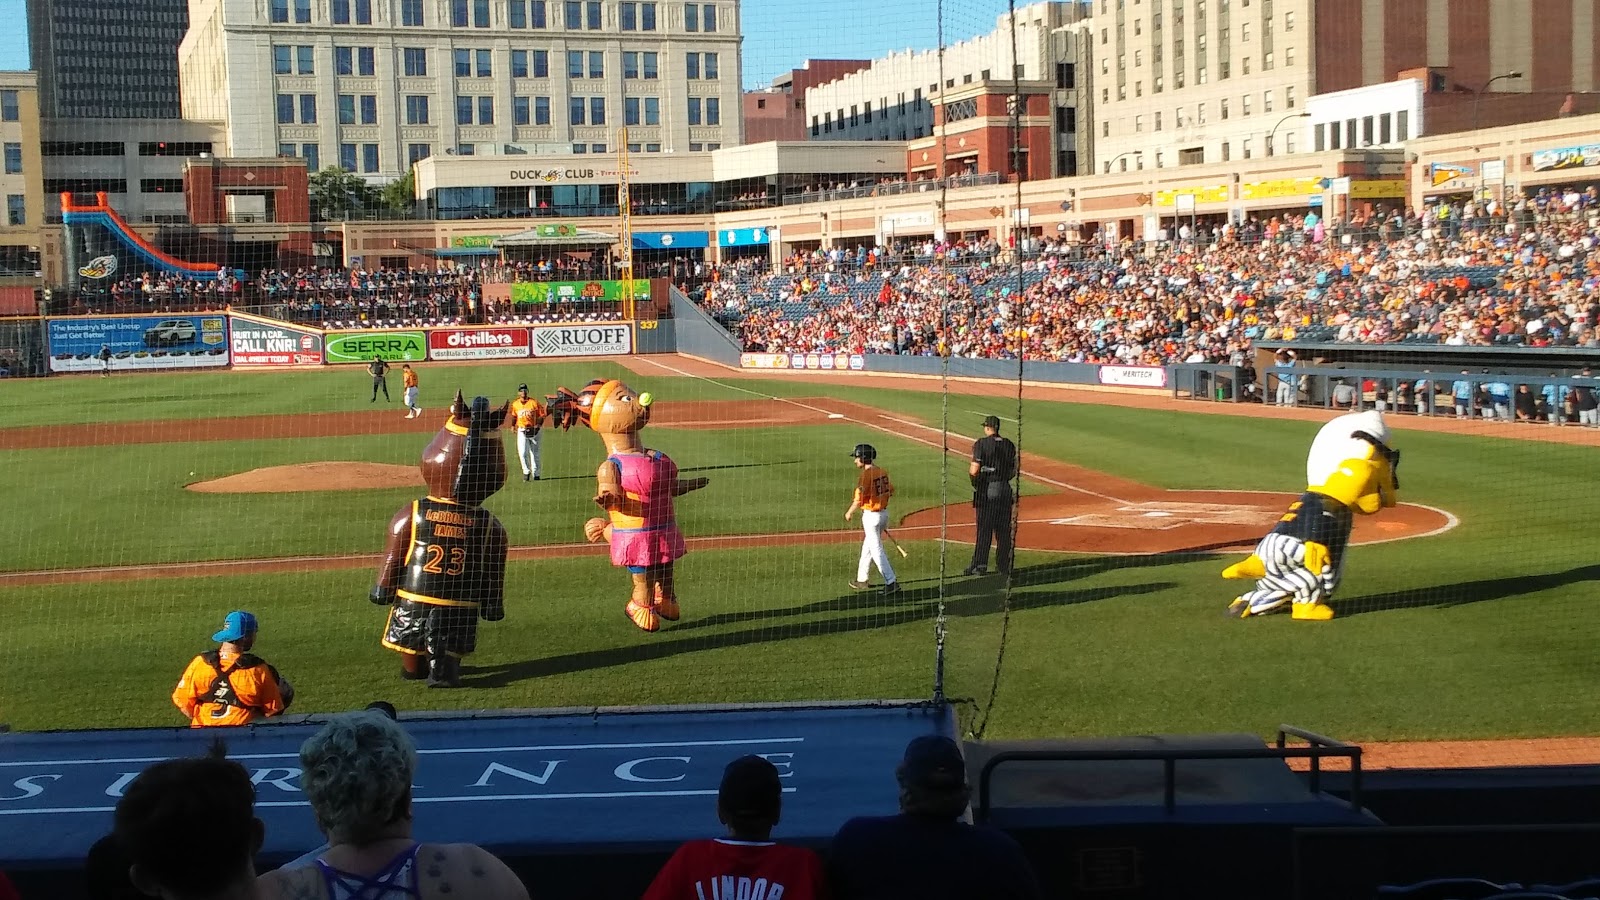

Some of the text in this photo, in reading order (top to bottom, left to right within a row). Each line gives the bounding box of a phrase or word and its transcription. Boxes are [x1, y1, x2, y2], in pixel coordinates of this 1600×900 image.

[510, 169, 594, 180] DUCK CLUB
[67, 324, 100, 332] Industry's
[117, 322, 140, 331] Lineup
[640, 321, 658, 330] 337
[233, 331, 251, 339] HURT
[447, 331, 513, 347] distillata
[561, 329, 625, 344] RUOFF
[234, 339, 264, 352] CALL
[266, 339, 297, 352] KNR!
[343, 340, 419, 353] SERRA
[561, 344, 626, 353] HOME MORTGAGE
[434, 524, 466, 538] JAMES
[423, 545, 465, 576] 23
